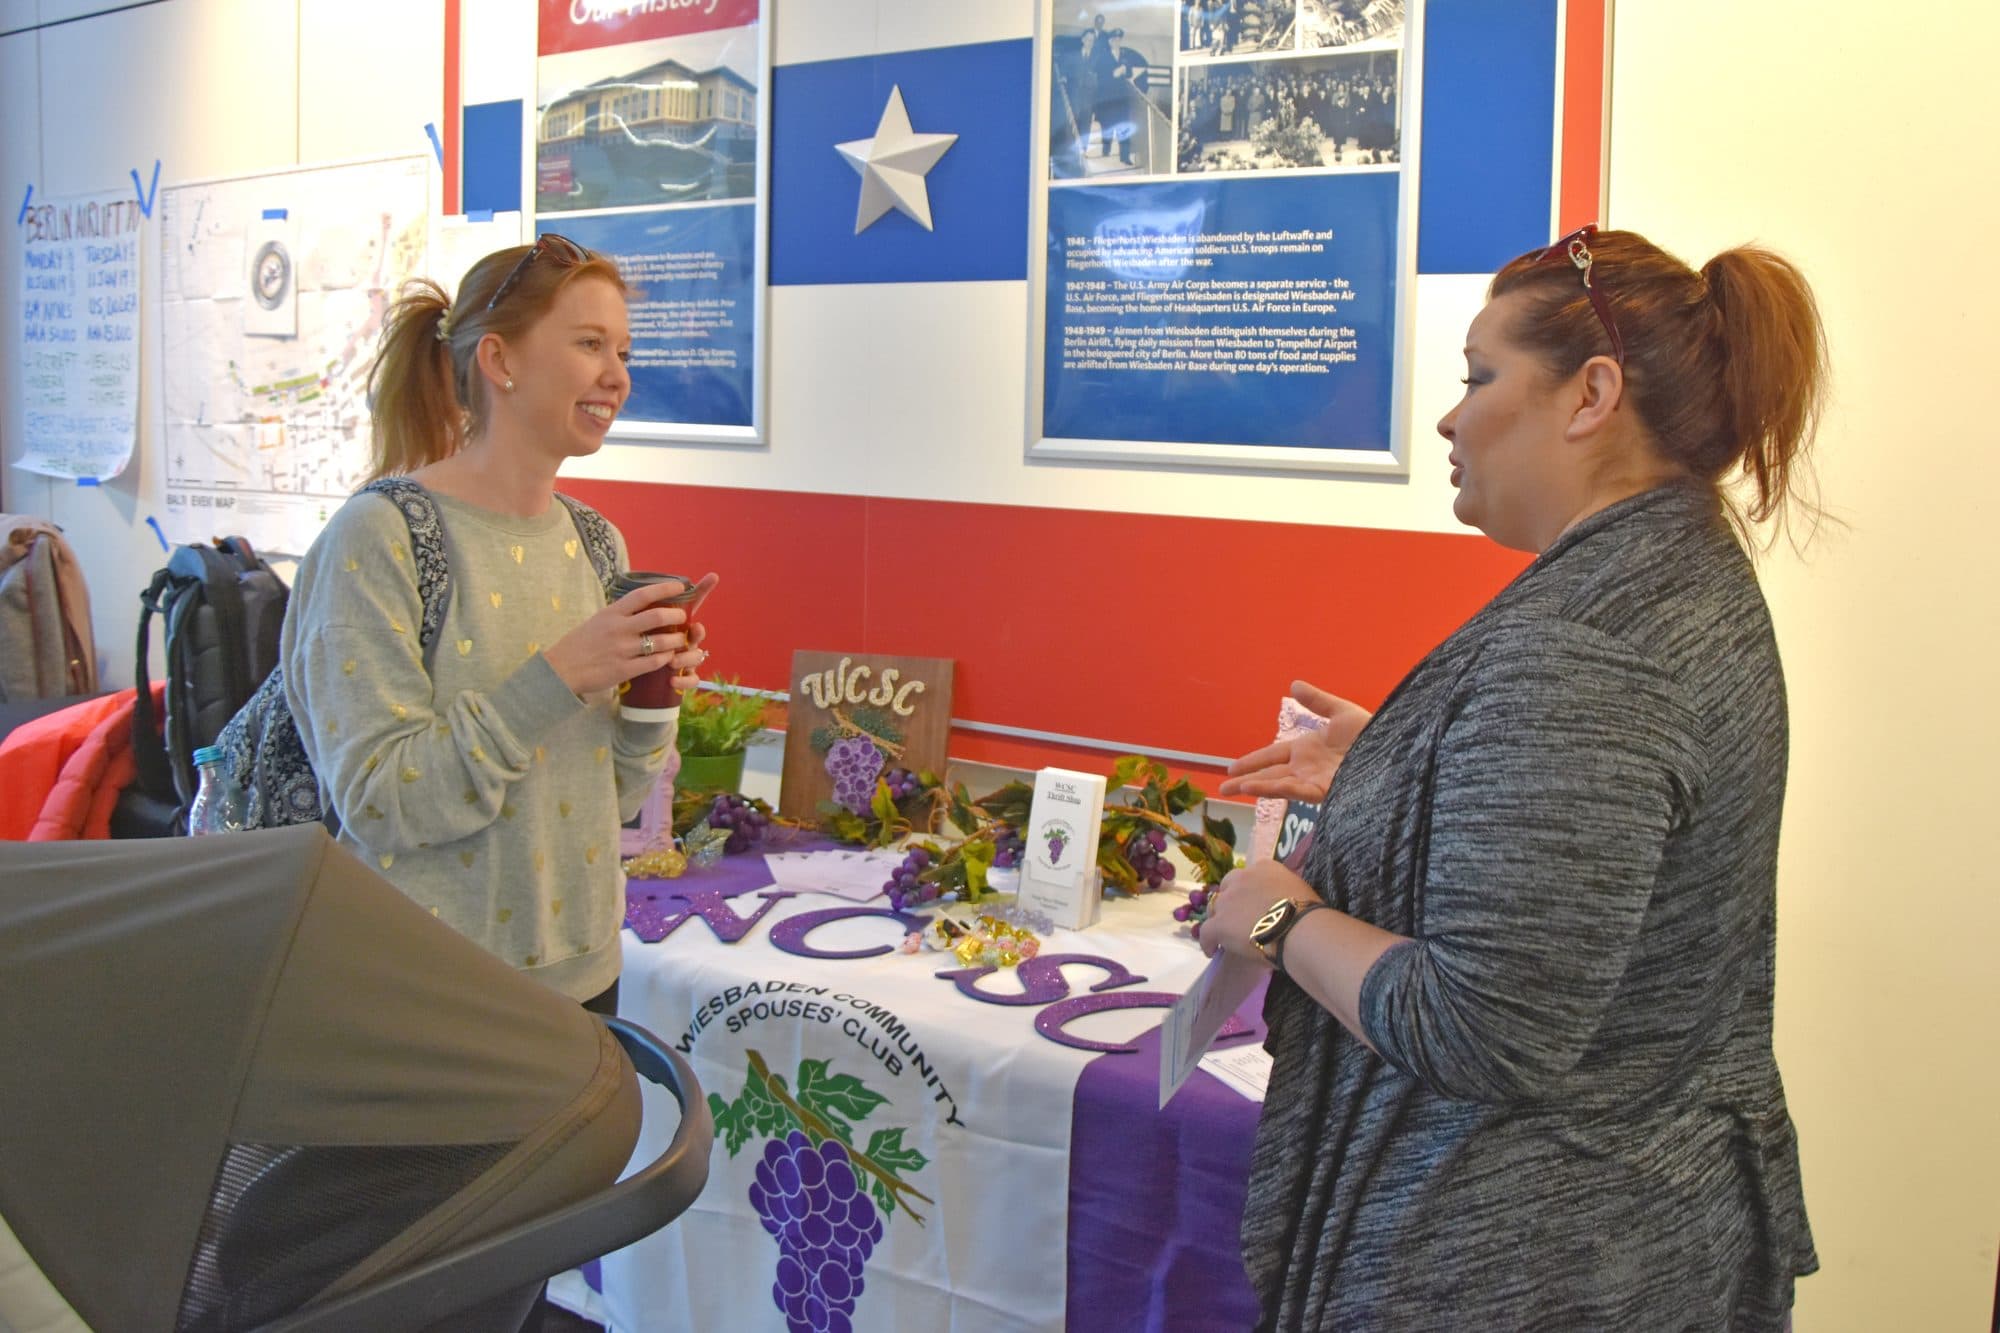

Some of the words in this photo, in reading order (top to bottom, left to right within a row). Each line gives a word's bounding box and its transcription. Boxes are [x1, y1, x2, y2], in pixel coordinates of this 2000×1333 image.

[26, 203, 72, 243] BERLIN
[1066, 237, 1085, 246] 1945
[1142, 234, 1186, 243] Wiesbaden
[1188, 234, 1194, 243] is
[1196, 232, 1242, 242] abandoned
[1244, 231, 1255, 243] by
[1256, 231, 1271, 241] the
[1272, 230, 1315, 241] Luftwaffe
[1316, 229, 1333, 240] and
[1066, 248, 1100, 258] occupied
[1102, 248, 1111, 258] by
[1112, 247, 1153, 257] advancing
[1154, 246, 1193, 255] American
[1195, 244, 1230, 254] soldiers.
[1231, 243, 1248, 253] U.S.
[1251, 244, 1278, 255] troops
[1280, 243, 1311, 252] remain
[1312, 244, 1324, 252] on
[1066, 259, 1111, 271] Fliegerhorst
[1112, 258, 1155, 268] Wiesbaden
[1158, 257, 1179, 267] after
[1180, 257, 1194, 266] the
[1195, 258, 1214, 267] war.
[1066, 281, 1106, 290] 1947-1948
[1113, 281, 1128, 289] The
[1129, 281, 1146, 289] U.S.
[1148, 280, 1169, 291] Army
[1171, 280, 1184, 289] Air
[1186, 280, 1210, 291] Corps
[1211, 279, 1248, 289] becomes
[1256, 279, 1294, 290] separate
[1295, 279, 1327, 288] service
[1333, 278, 1349, 288] the
[1066, 292, 1081, 301] U.S.
[1083, 292, 1095, 301] Air
[1121, 292, 1136, 301] and
[1137, 291, 1184, 303] Fliegerhorst
[1186, 291, 1232, 300] Wiesbaden
[1234, 291, 1241, 300] is
[1242, 291, 1289, 302] designated
[1290, 290, 1340, 300] Wiesbaden
[1341, 290, 1355, 300] Air
[1087, 304, 1123, 315] becoming
[1125, 304, 1138, 313] the
[1139, 304, 1162, 313] home
[1163, 303, 1173, 312] of
[1174, 303, 1231, 314] Headquarters
[1232, 303, 1250, 312] U.S.
[1251, 303, 1265, 312] Air
[1267, 303, 1291, 312] Force
[1292, 303, 1301, 312] in
[1303, 303, 1337, 314] Europe.
[1064, 326, 1106, 335] 1948-1949
[1113, 326, 1143, 335] Airmen
[1144, 326, 1164, 335] from
[1165, 326, 1209, 335] Wiesbaden
[1211, 326, 1257, 338] distinguish
[1259, 326, 1308, 336] themselves
[1309, 326, 1338, 338] during
[1340, 327, 1355, 337] the
[1064, 338, 1087, 346] Berlin
[1115, 338, 1137, 349] flying
[1138, 338, 1158, 349] daily
[1159, 338, 1193, 347] missions
[1194, 338, 1215, 347] from
[1216, 338, 1263, 348] Wiesbaden
[1265, 339, 1274, 348] to
[1275, 338, 1323, 350] Tempelhof
[1323, 339, 1357, 351] Airport
[1064, 349, 1072, 358] in
[1073, 349, 1085, 358] the
[1087, 349, 1135, 360] beleaguered
[1136, 349, 1151, 360] city
[1152, 349, 1161, 358] of
[1162, 349, 1188, 359] Berlin.
[1190, 350, 1212, 359] More
[1214, 350, 1233, 359] than
[1234, 350, 1246, 359] 80
[1248, 351, 1267, 360] tons
[1268, 350, 1278, 360] of
[1279, 350, 1300, 360] food
[1301, 351, 1319, 360] and
[1319, 351, 1356, 363] supplies
[1063, 361, 1076, 369] are
[1077, 360, 1107, 369] airlifted
[1108, 360, 1128, 369] from
[1129, 361, 1173, 370] Wiesbaden
[1174, 361, 1186, 370] Air
[1188, 361, 1208, 371] Base
[1209, 362, 1237, 374] during
[1238, 363, 1255, 371] one
[1256, 362, 1278, 374] day's
[1279, 363, 1330, 374] operations.
[800, 656, 926, 717] WCSC
[725, 999, 842, 1035] SPOUSES'
[842, 1017, 905, 1078] CLUB
[675, 980, 829, 1055] WIESBADEN
[832, 993, 966, 1129] COMMUNITY
